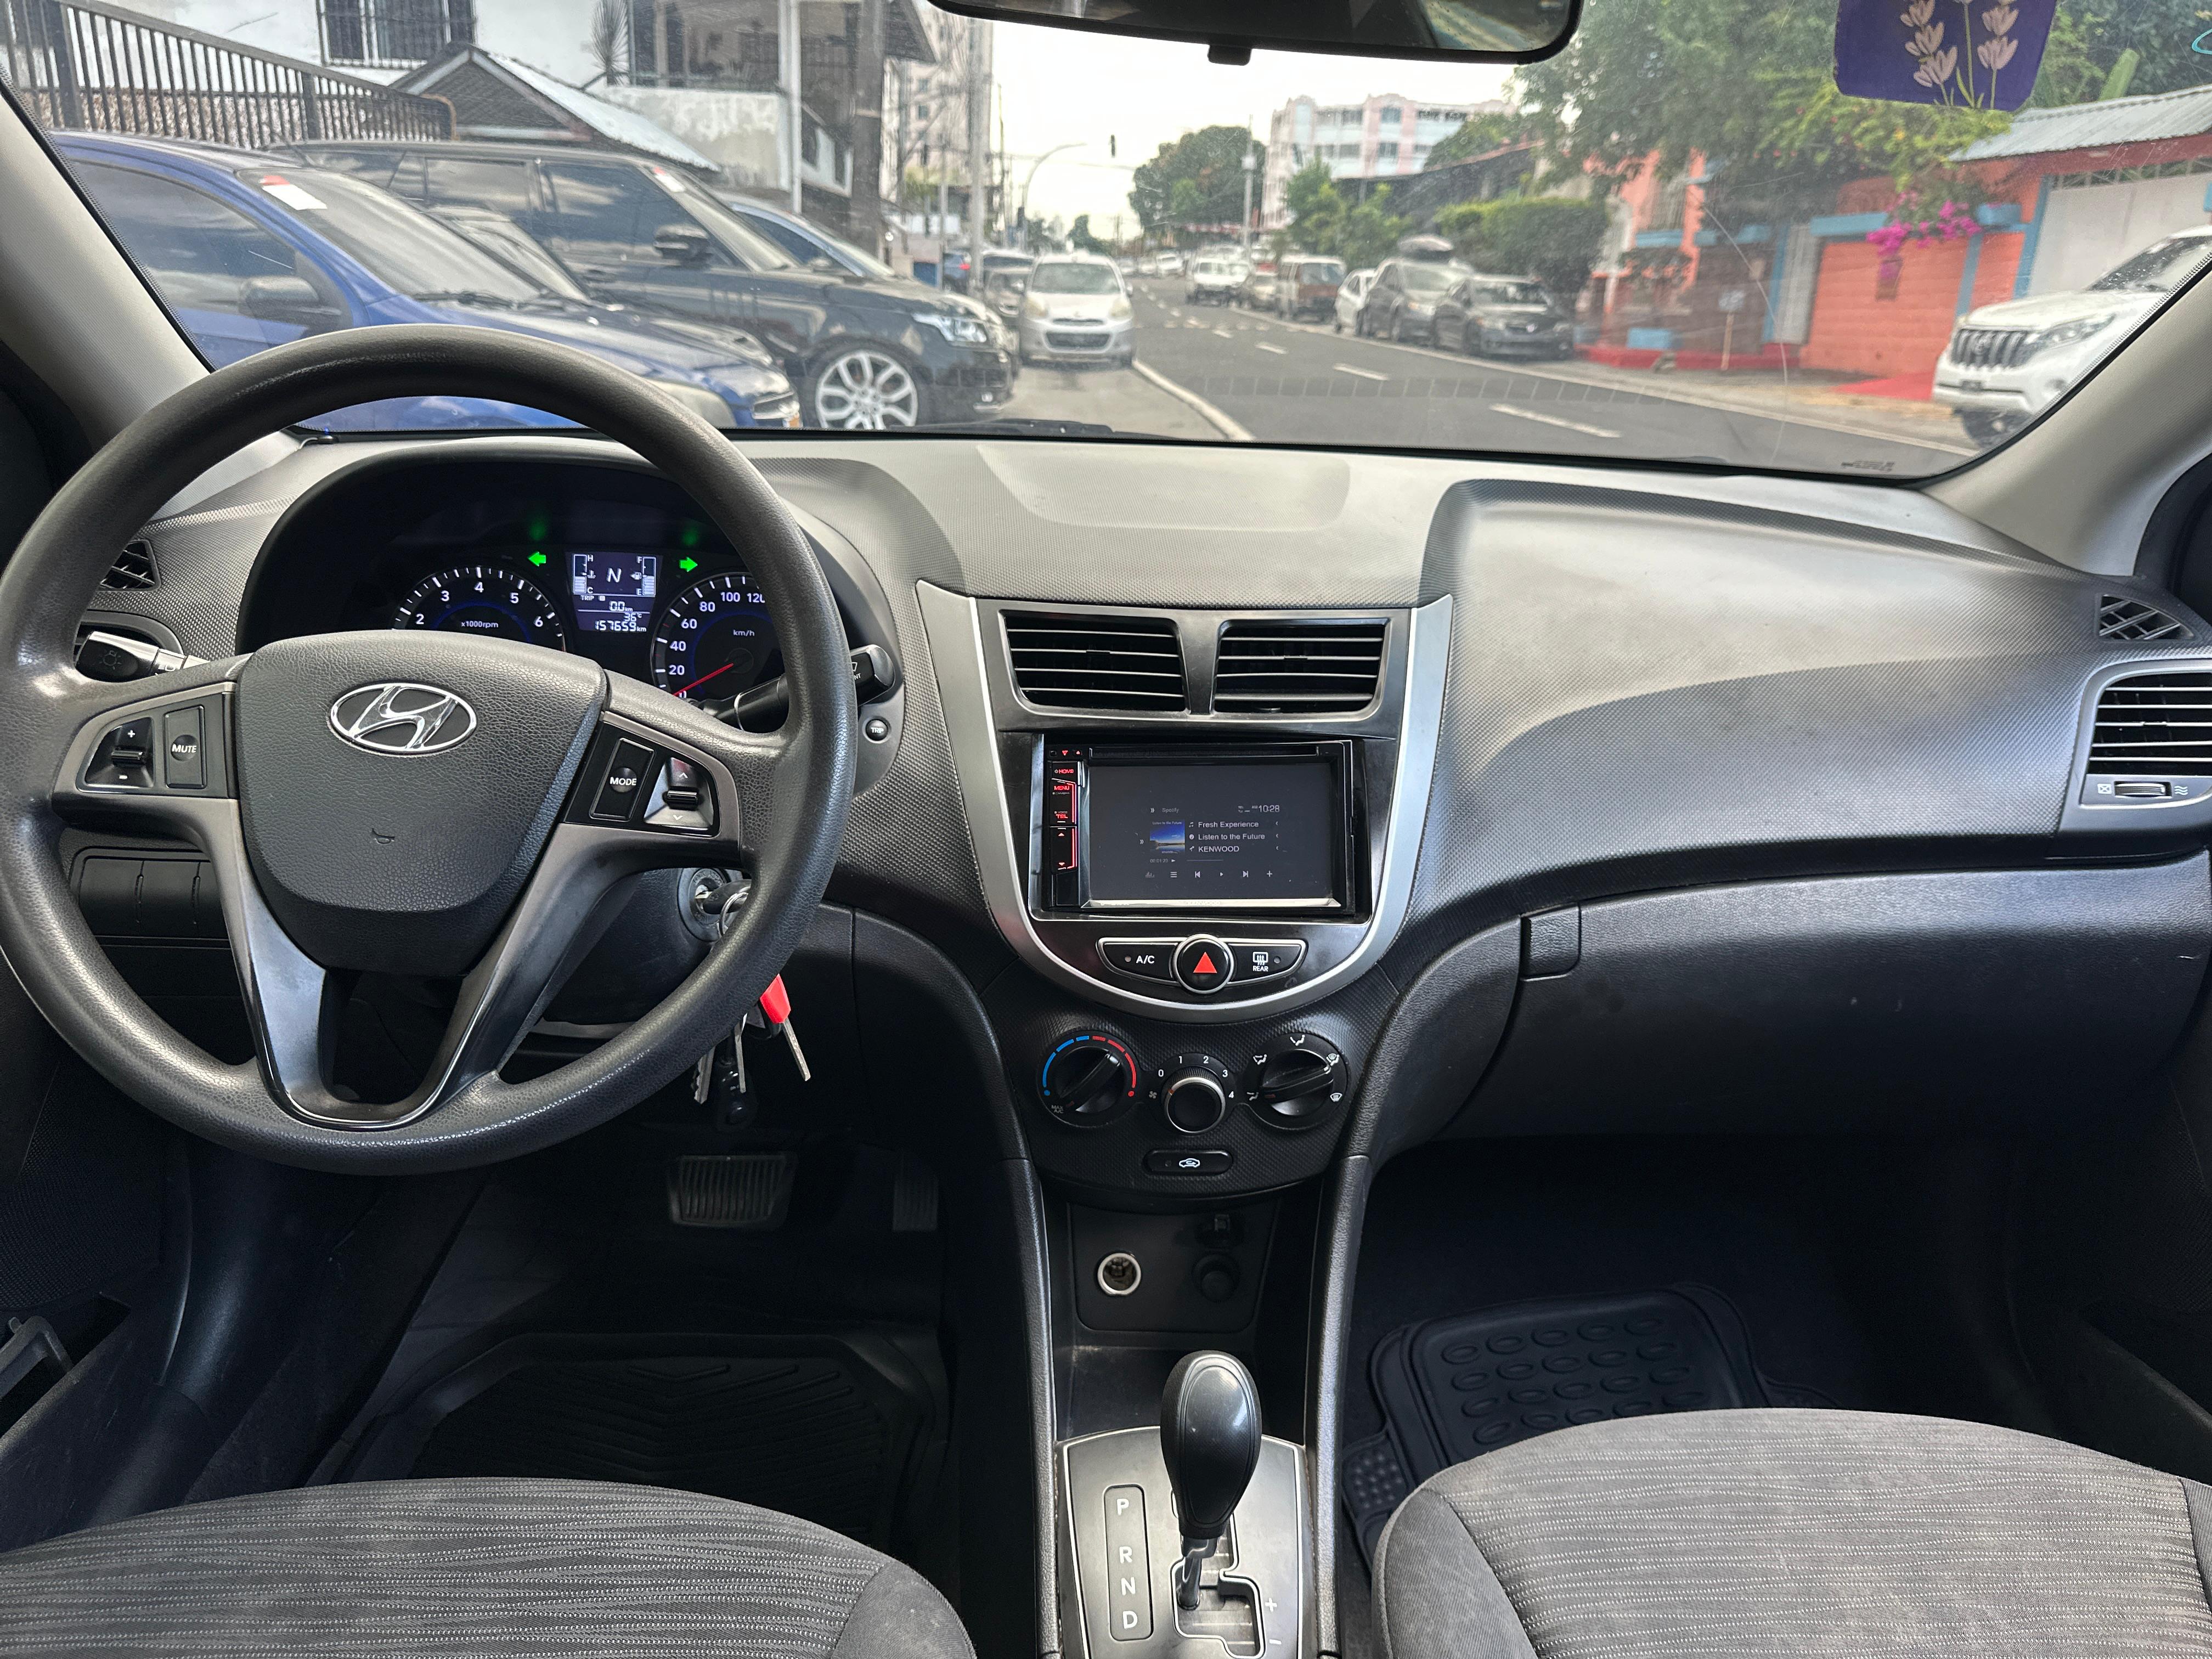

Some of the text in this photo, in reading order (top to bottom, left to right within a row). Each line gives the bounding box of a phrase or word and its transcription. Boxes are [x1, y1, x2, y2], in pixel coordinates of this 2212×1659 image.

[606, 567, 622, 583] N
[474, 582, 484, 592] 4
[441, 590, 449, 601] 3
[510, 592, 518, 603] 5
[720, 592, 740, 602] 100
[699, 601, 715, 612] 80
[415, 613, 424, 624] 2
[534, 616, 543, 627] 6
[681, 619, 697, 629] 60
[669, 641, 686, 651] 40
[669, 665, 685, 675] 20
[172, 744, 197, 753] MUTE
[610, 777, 637, 786] MODE
[1136, 955, 1155, 964] A/C
[1178, 1056, 1183, 1064] 1
[1203, 1056, 1209, 1064] 2
[1222, 1069, 1228, 1077] 3
[1116, 1498, 1130, 1515] P
[1119, 1546, 1133, 1564] R
[1121, 1577, 1136, 1595] N
[1122, 1610, 1138, 1629] D
